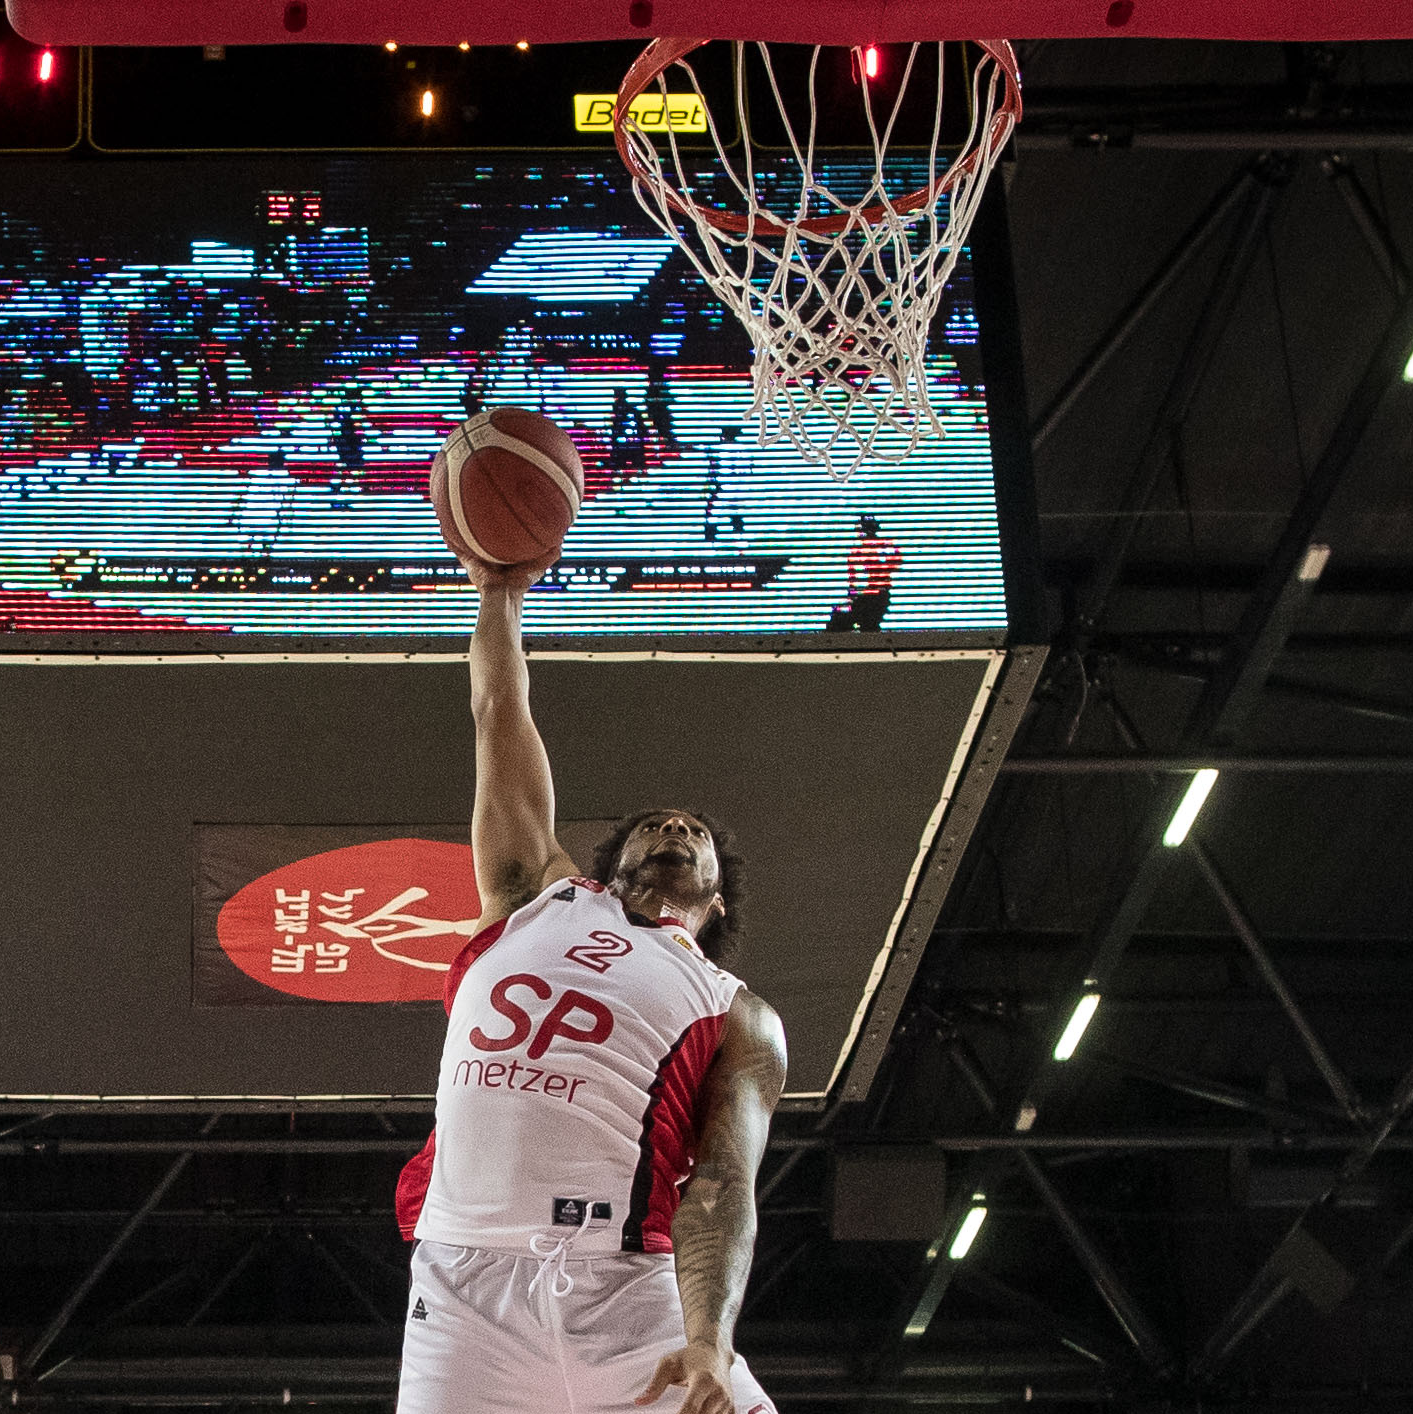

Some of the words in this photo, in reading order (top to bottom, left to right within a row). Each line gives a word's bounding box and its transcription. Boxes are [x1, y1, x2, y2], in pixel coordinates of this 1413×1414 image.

[564, 930, 633, 974] 2
[469, 973, 614, 1060] SP
[453, 1059, 587, 1104] metzer
